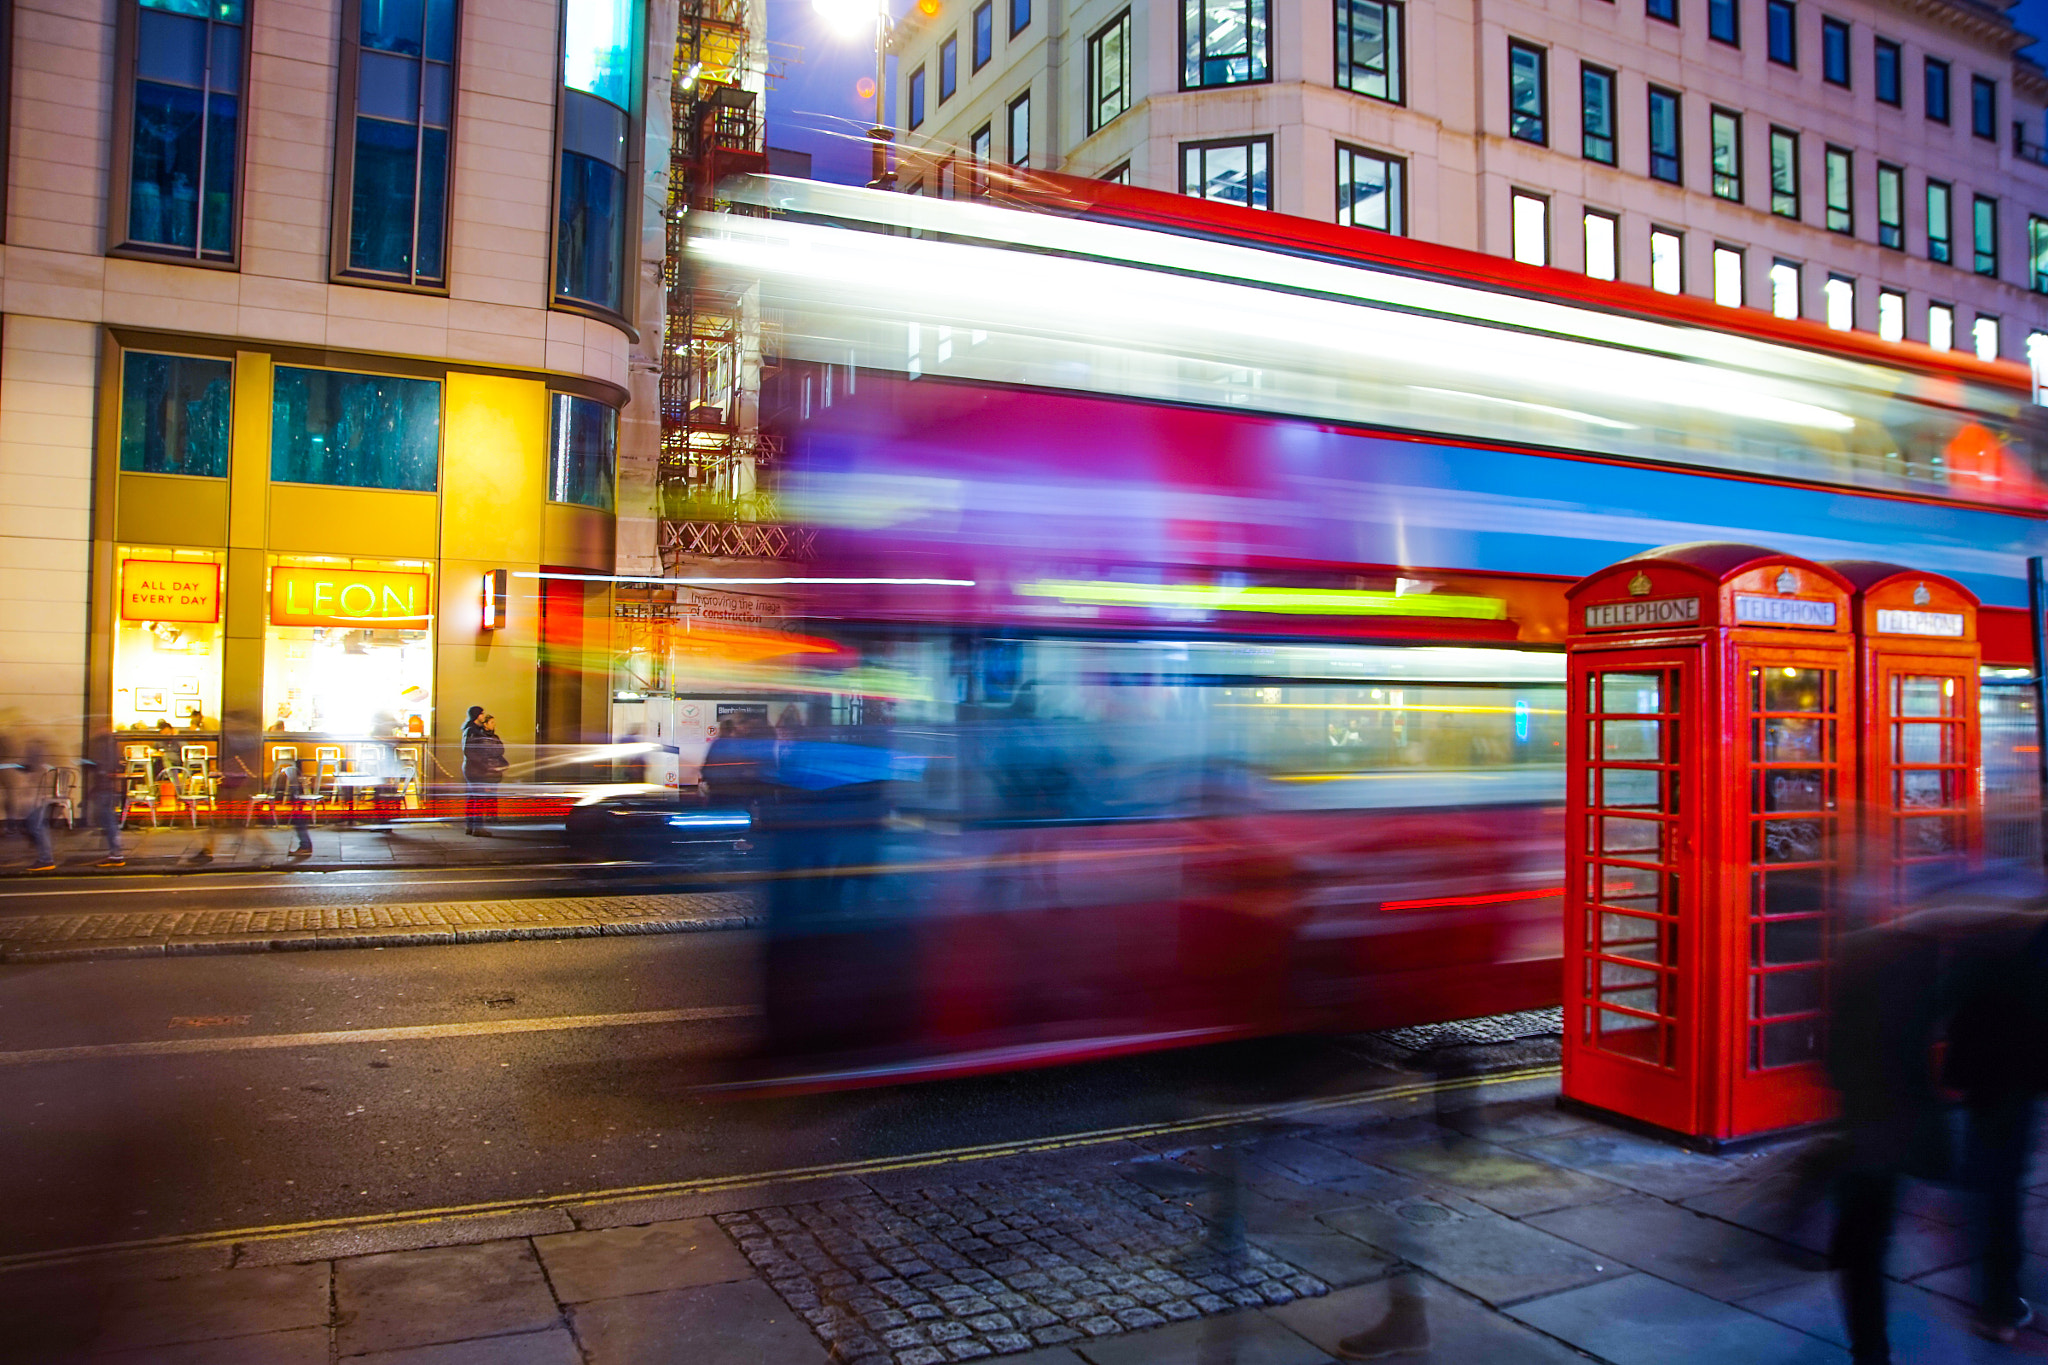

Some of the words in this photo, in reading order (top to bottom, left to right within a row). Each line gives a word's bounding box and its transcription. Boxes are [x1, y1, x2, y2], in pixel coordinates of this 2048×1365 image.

[140, 581, 166, 591] ALL
[172, 582, 199, 591] DAY
[132, 594, 174, 604] EVERY
[180, 595, 207, 605] DAY
[286, 579, 415, 617] LEON
[691, 592, 737, 611] Improving
[740, 598, 754, 610] the
[703, 609, 762, 623] construction
[1590, 599, 1698, 625] TELEPHONE
[1740, 600, 1832, 623] TELEPHONE
